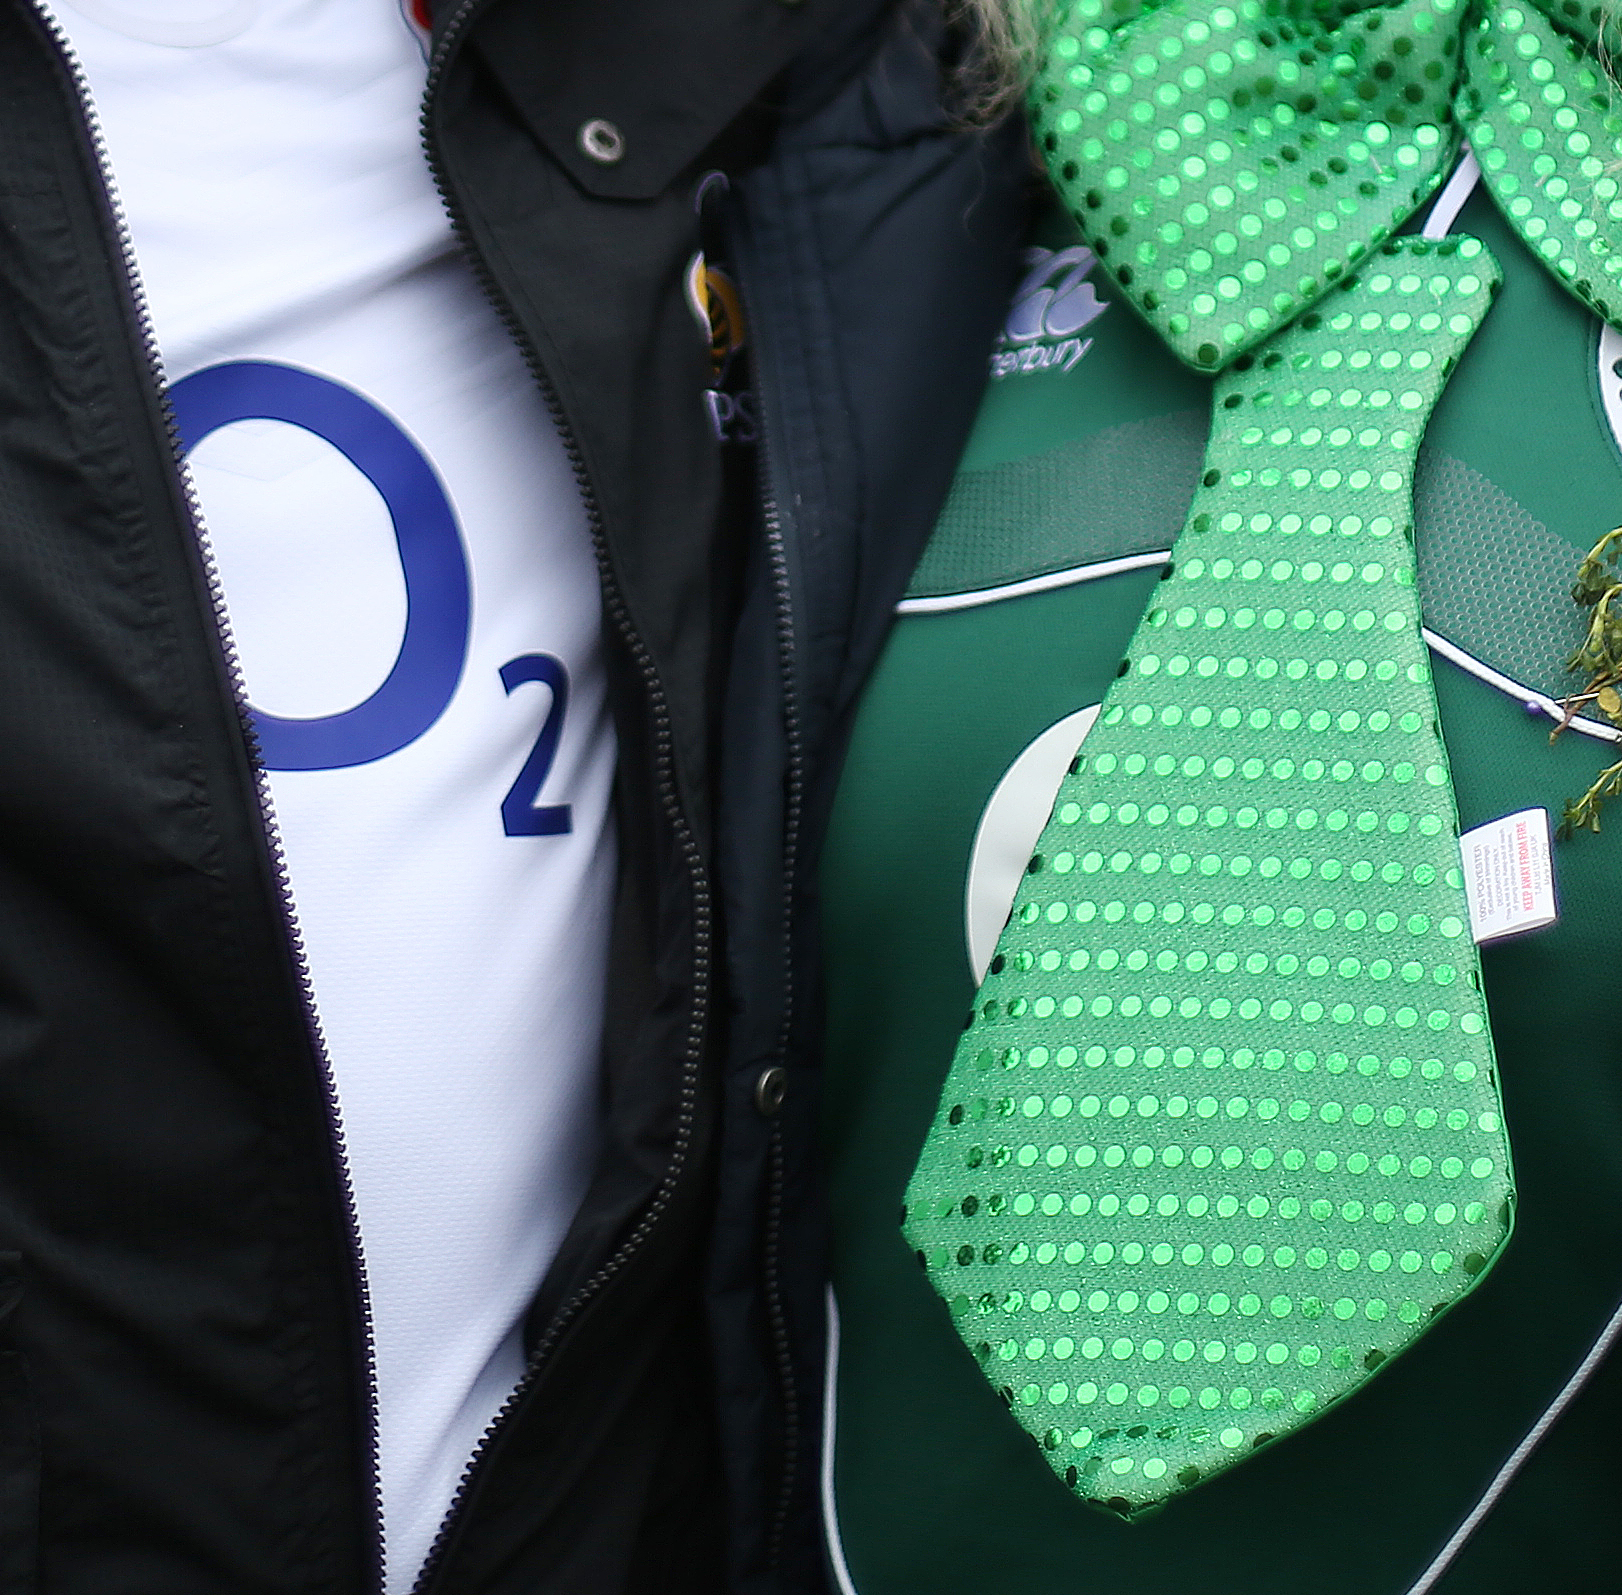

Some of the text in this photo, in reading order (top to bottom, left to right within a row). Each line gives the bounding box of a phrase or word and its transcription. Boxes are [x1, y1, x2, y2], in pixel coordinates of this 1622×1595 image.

[1473, 844, 1487, 922] 100% POLYESTER
[1492, 847, 1503, 906] DECORATION ONLY
[1515, 820, 1534, 911] KEEP AWAY FROM FIRE
